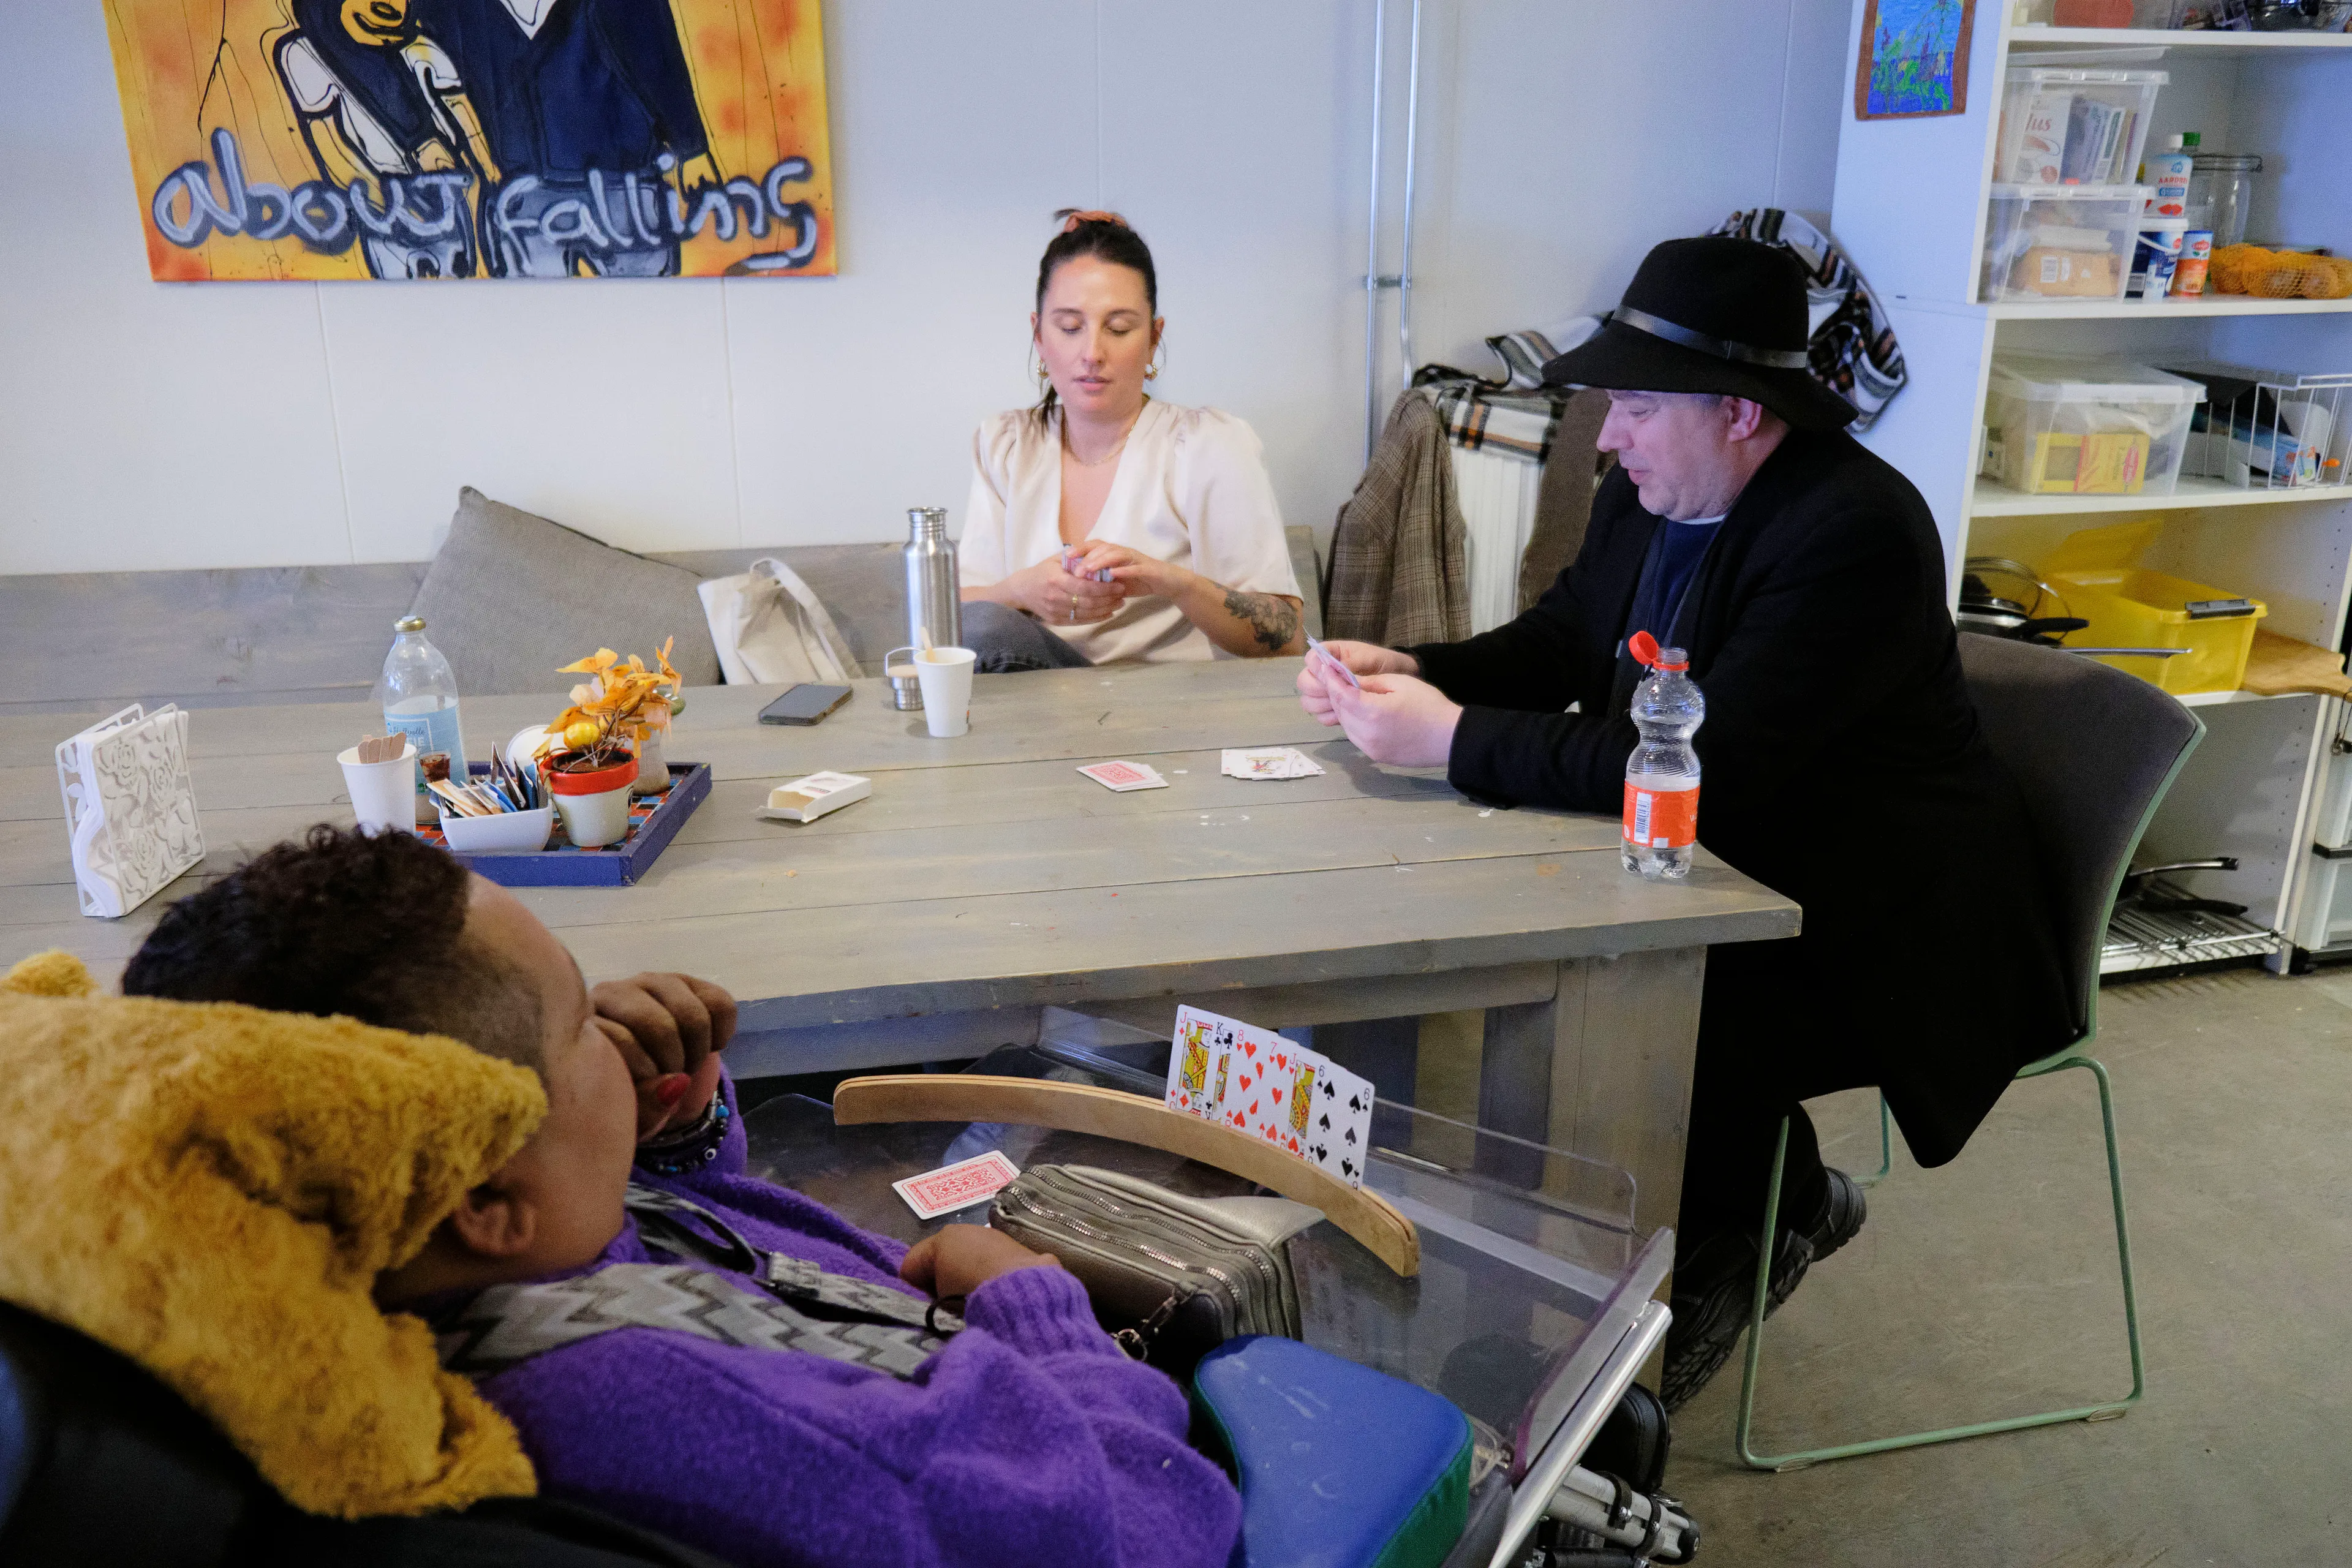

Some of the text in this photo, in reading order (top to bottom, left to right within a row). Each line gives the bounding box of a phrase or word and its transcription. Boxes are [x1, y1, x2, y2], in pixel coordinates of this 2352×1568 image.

[1180, 1011, 1188, 1023] J
[1216, 1021, 1224, 1035] K
[1237, 1029, 1244, 1041] 8
[1270, 1041, 1278, 1054] 7
[1289, 1052, 1297, 1065] J
[1319, 1065, 1325, 1077] 6
[1363, 1087, 1370, 1101] 6
